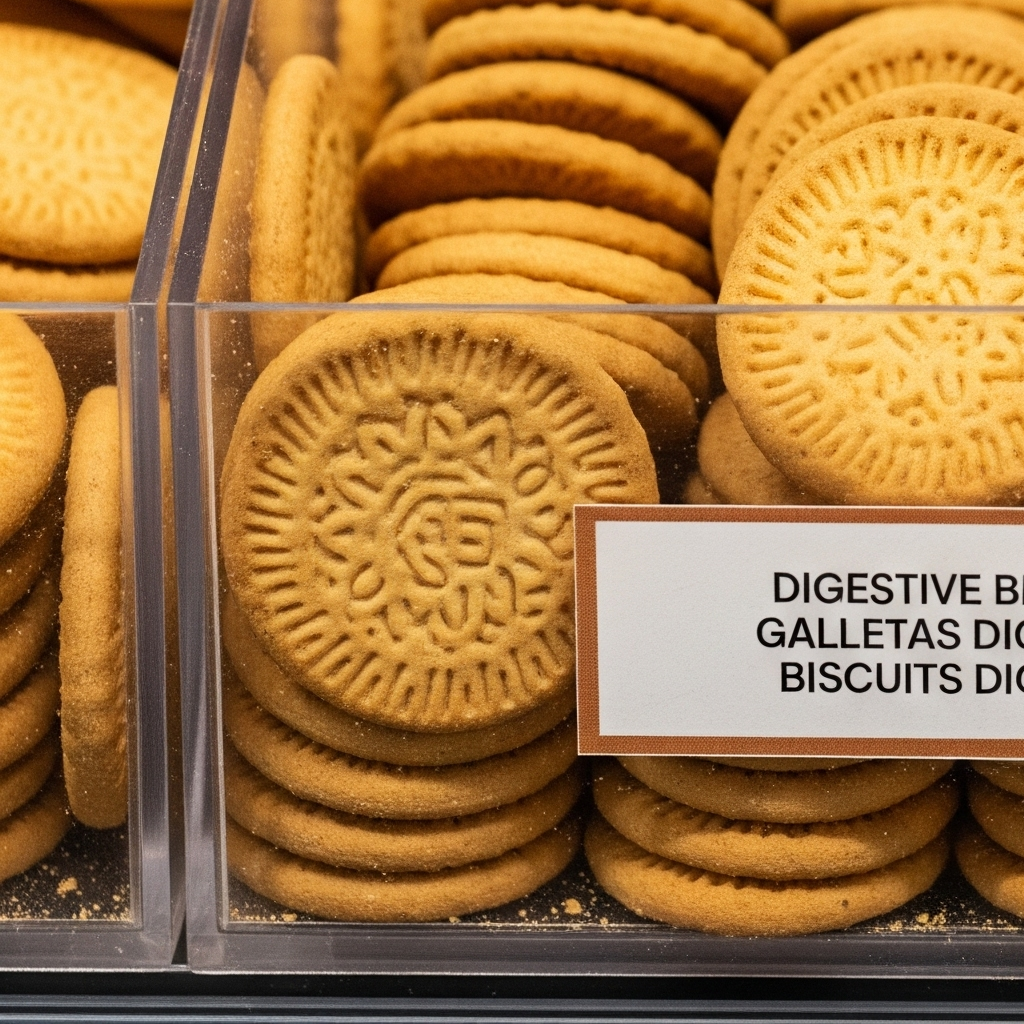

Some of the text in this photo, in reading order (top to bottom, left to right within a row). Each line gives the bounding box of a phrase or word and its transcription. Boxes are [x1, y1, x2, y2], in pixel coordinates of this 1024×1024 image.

[773, 571, 982, 606] DIGESTIVE
[756, 616, 961, 650] GALLETAS
[780, 661, 963, 695] BISCUITS
